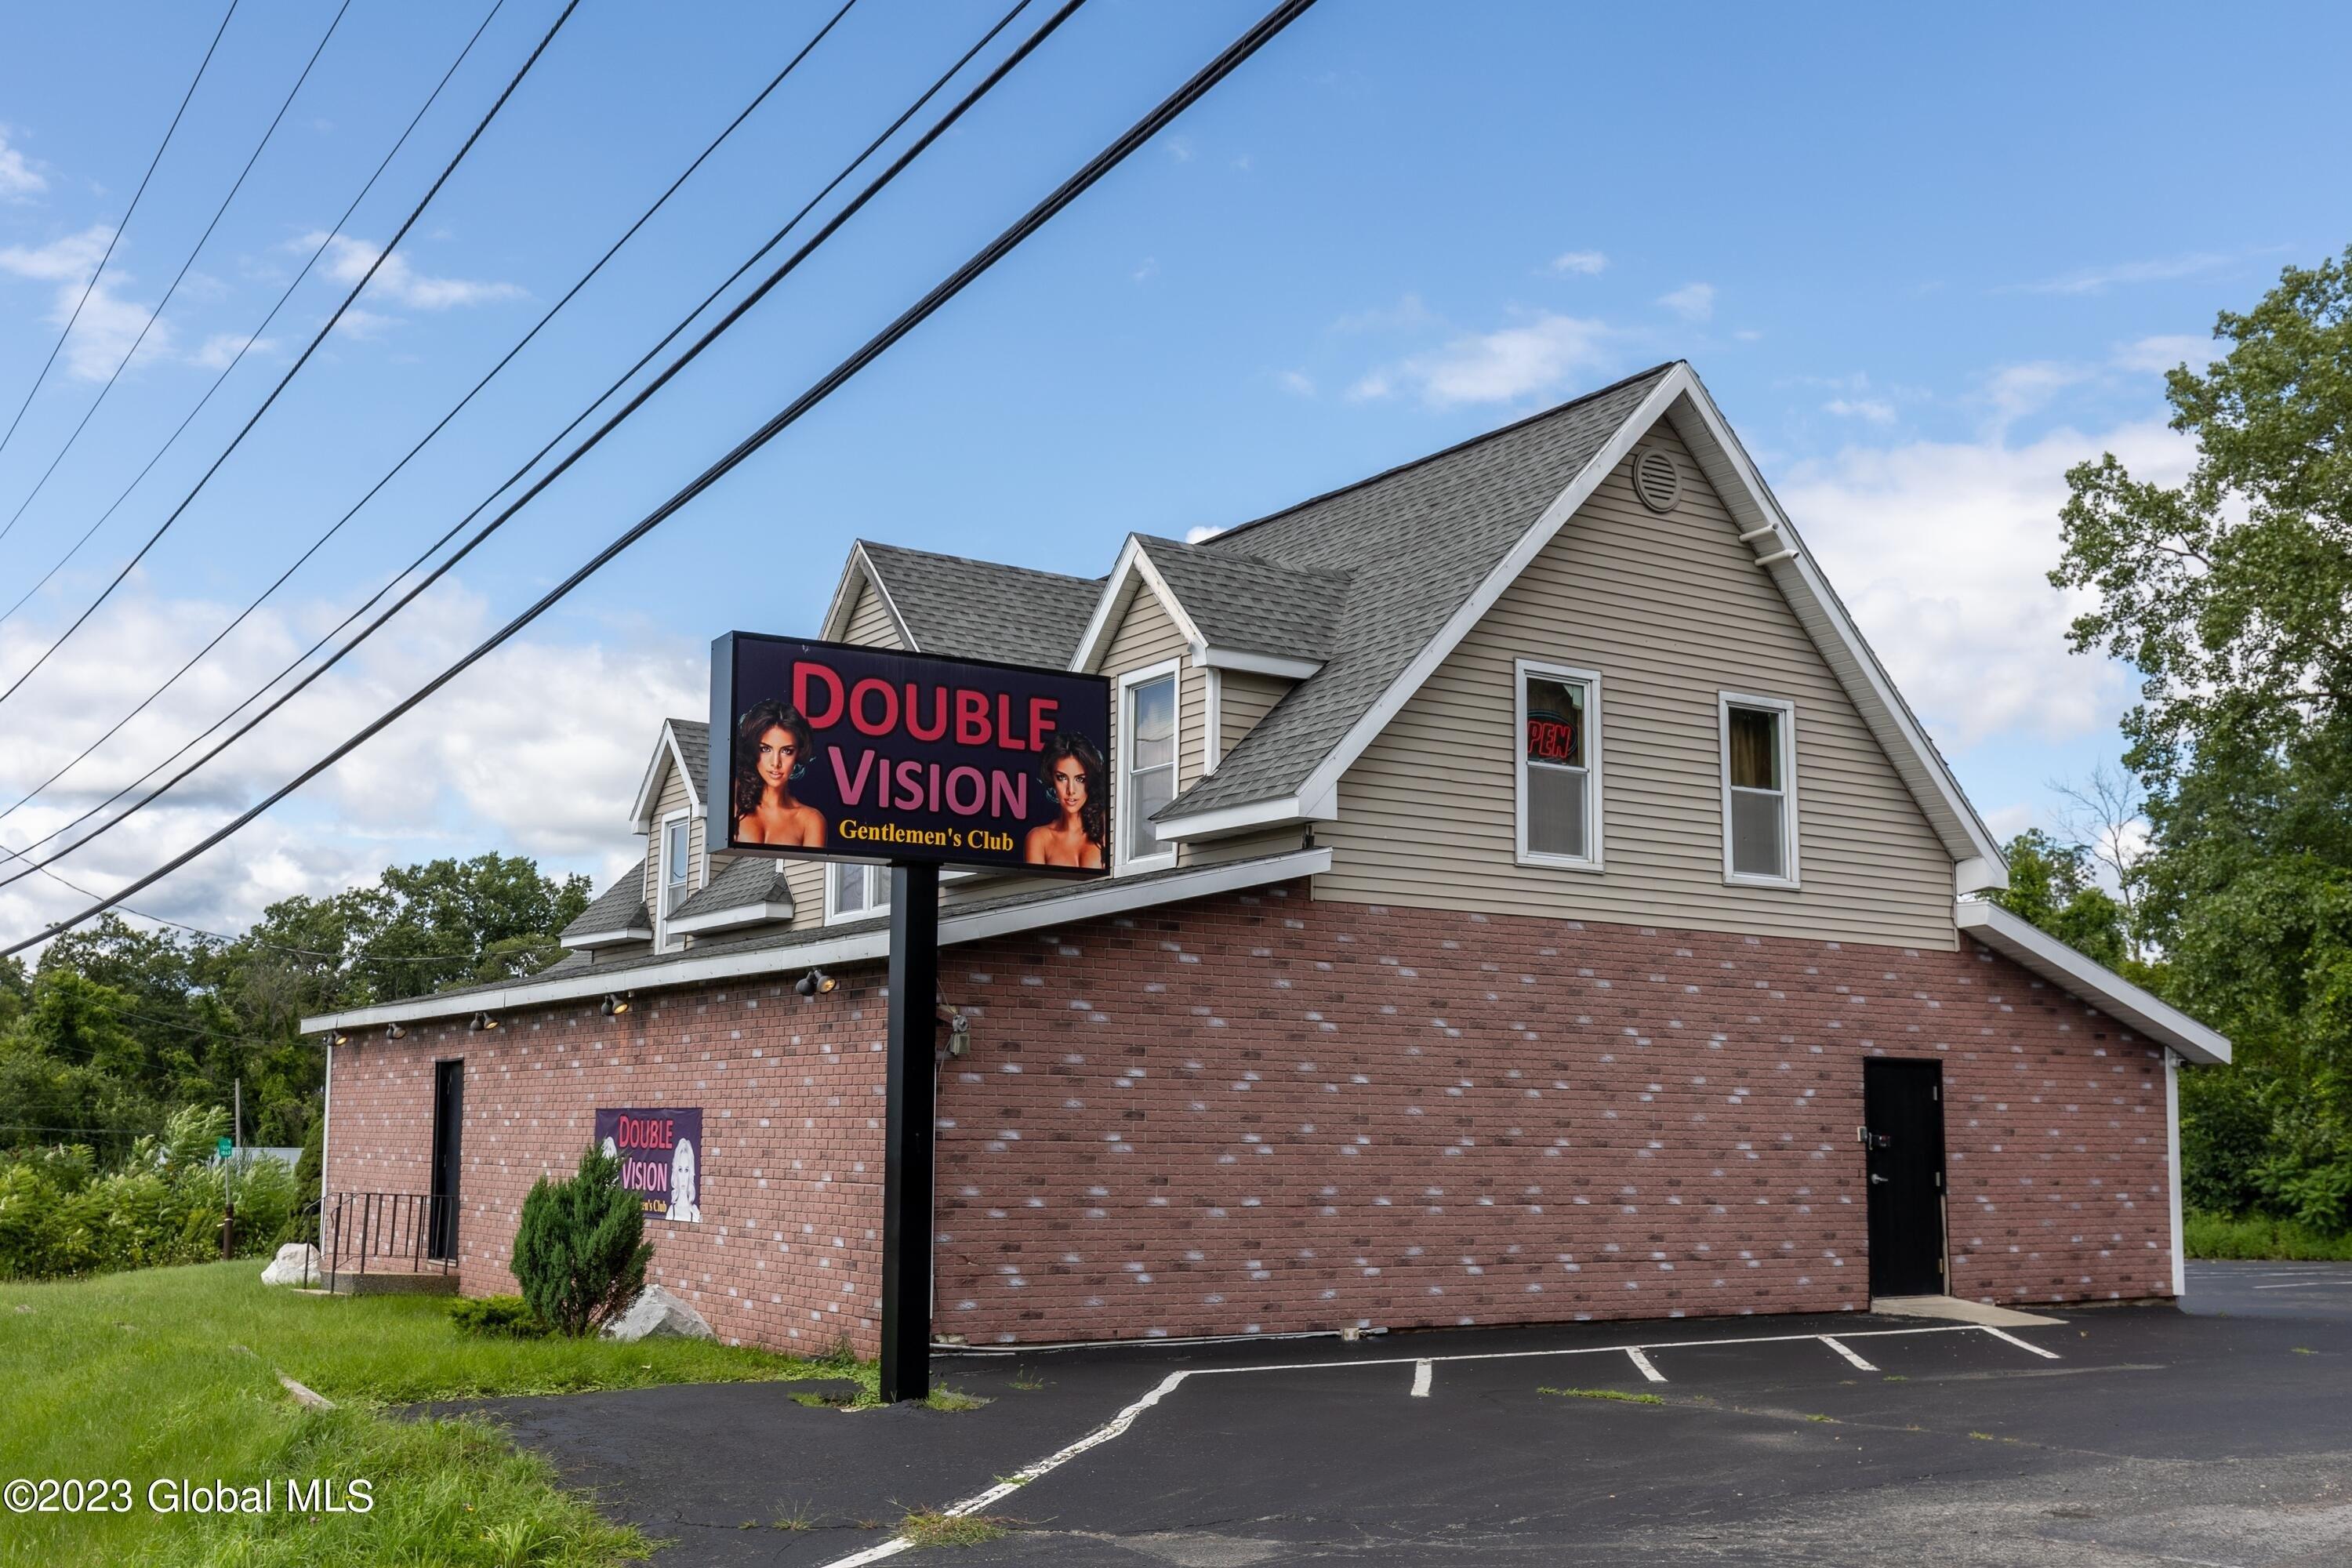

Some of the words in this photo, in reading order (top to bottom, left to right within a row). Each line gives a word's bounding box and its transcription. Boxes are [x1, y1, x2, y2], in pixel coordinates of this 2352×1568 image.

[793, 661, 1058, 752] DOUBLE
[1527, 720, 1570, 759] PEN
[827, 746, 1027, 820] VISION
[839, 819, 962, 848] Gentlemen's
[967, 828, 1014, 851] Club
[619, 1116, 674, 1149] DOUBLE
[621, 1157, 668, 1192] VISION
[653, 1200, 666, 1213] Club
